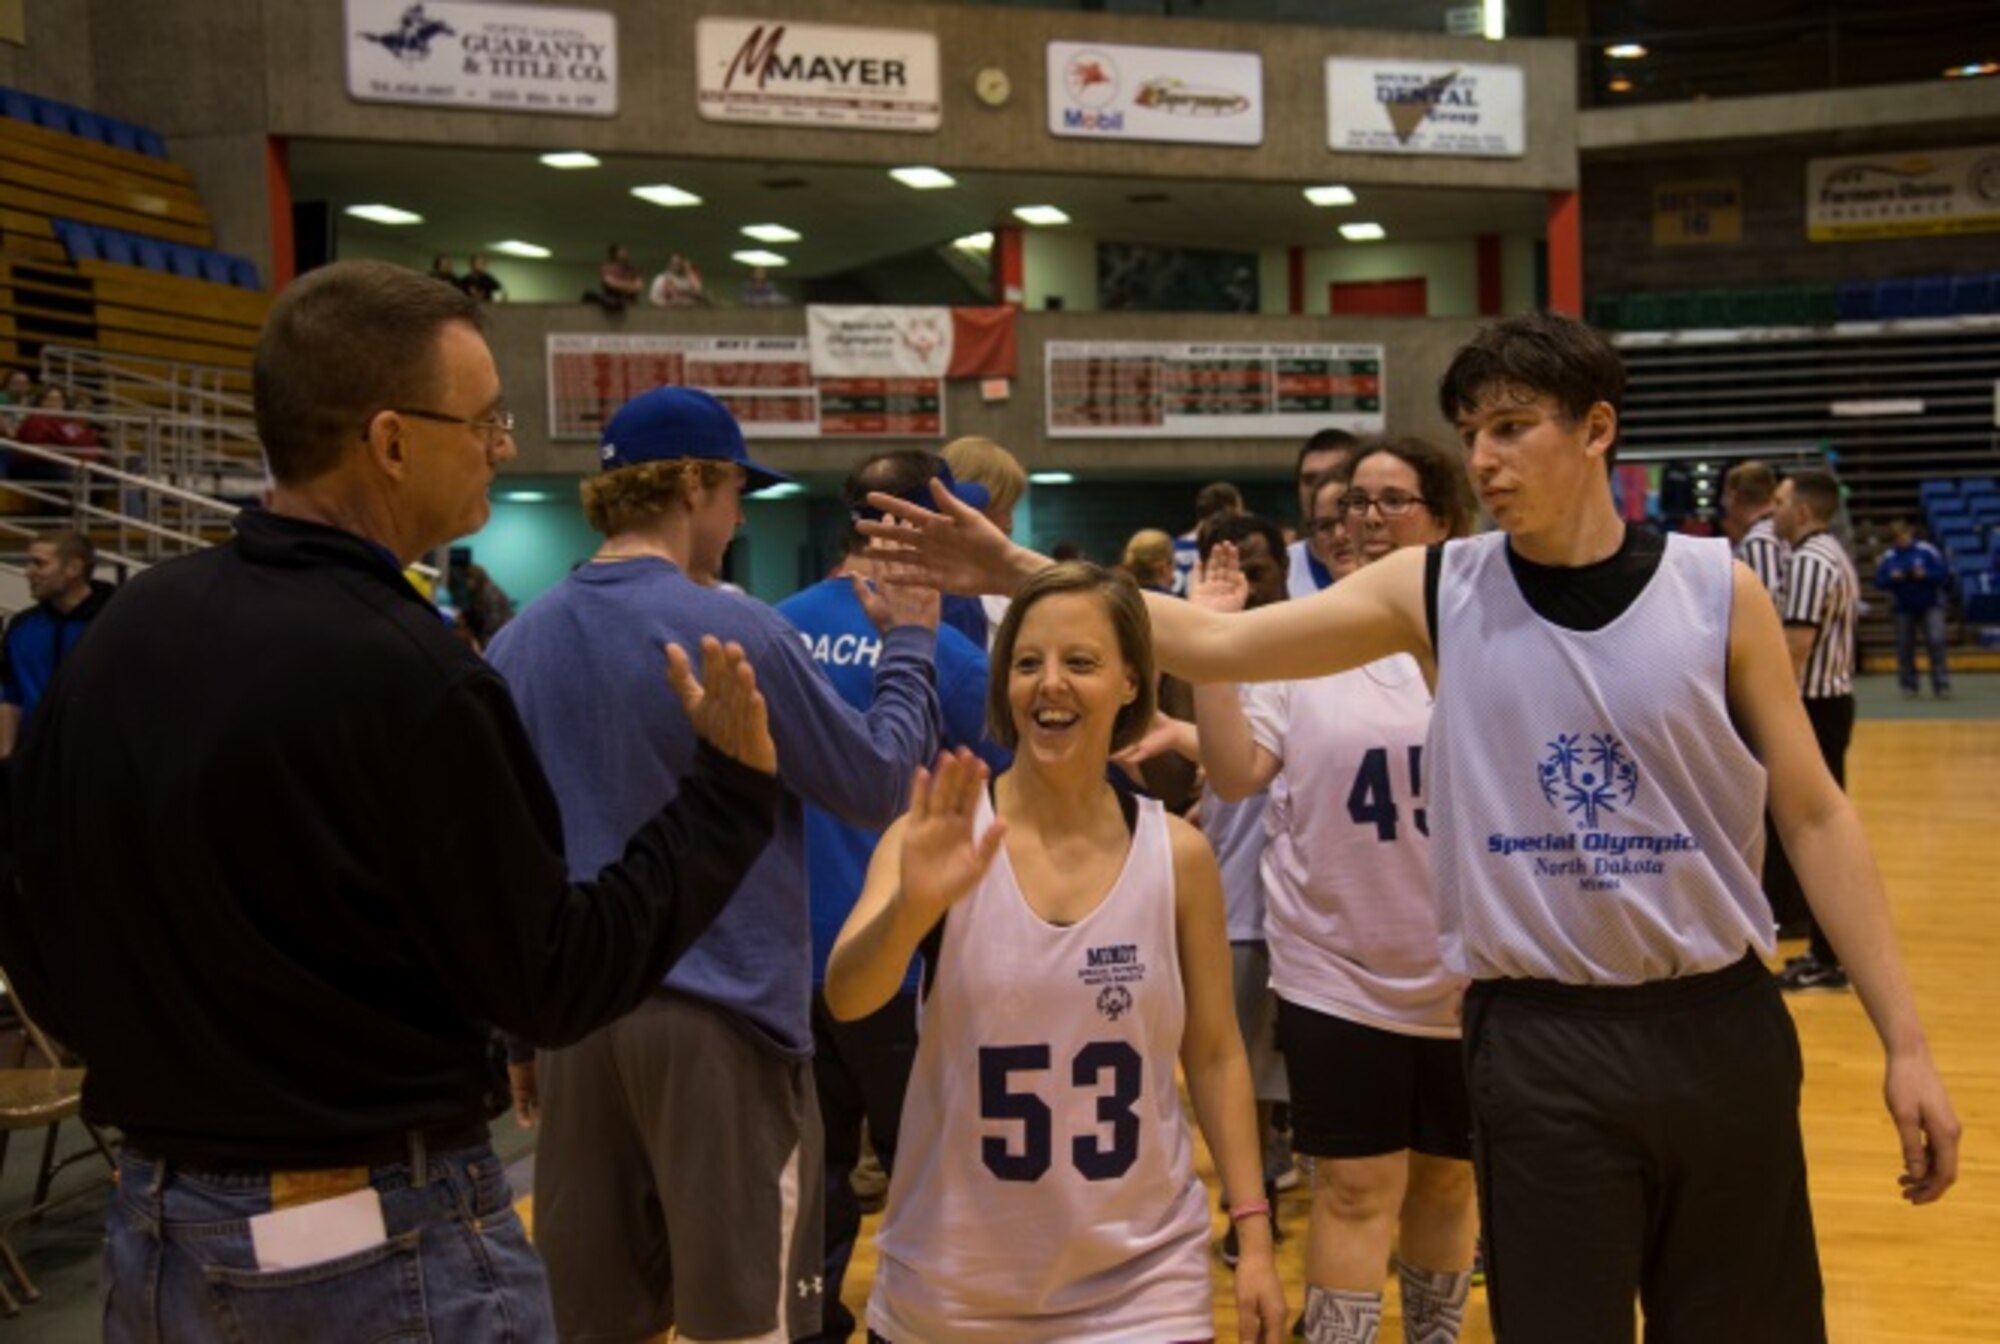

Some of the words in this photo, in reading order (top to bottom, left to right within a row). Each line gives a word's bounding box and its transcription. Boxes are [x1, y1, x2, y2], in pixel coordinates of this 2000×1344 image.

[461, 33, 606, 63] GUARANTY
[462, 56, 480, 75] &
[489, 58, 563, 80] TITLE
[769, 53, 907, 87] MAYER
[1376, 86, 1479, 107] DENTAL
[1063, 108, 1123, 131] Mobil
[1488, 833, 1575, 855] Special
[1583, 833, 1700, 855] Olympic
[1534, 857, 1587, 876] North
[1594, 857, 1664, 876] Dakota
[978, 1041, 1142, 1182] 53
